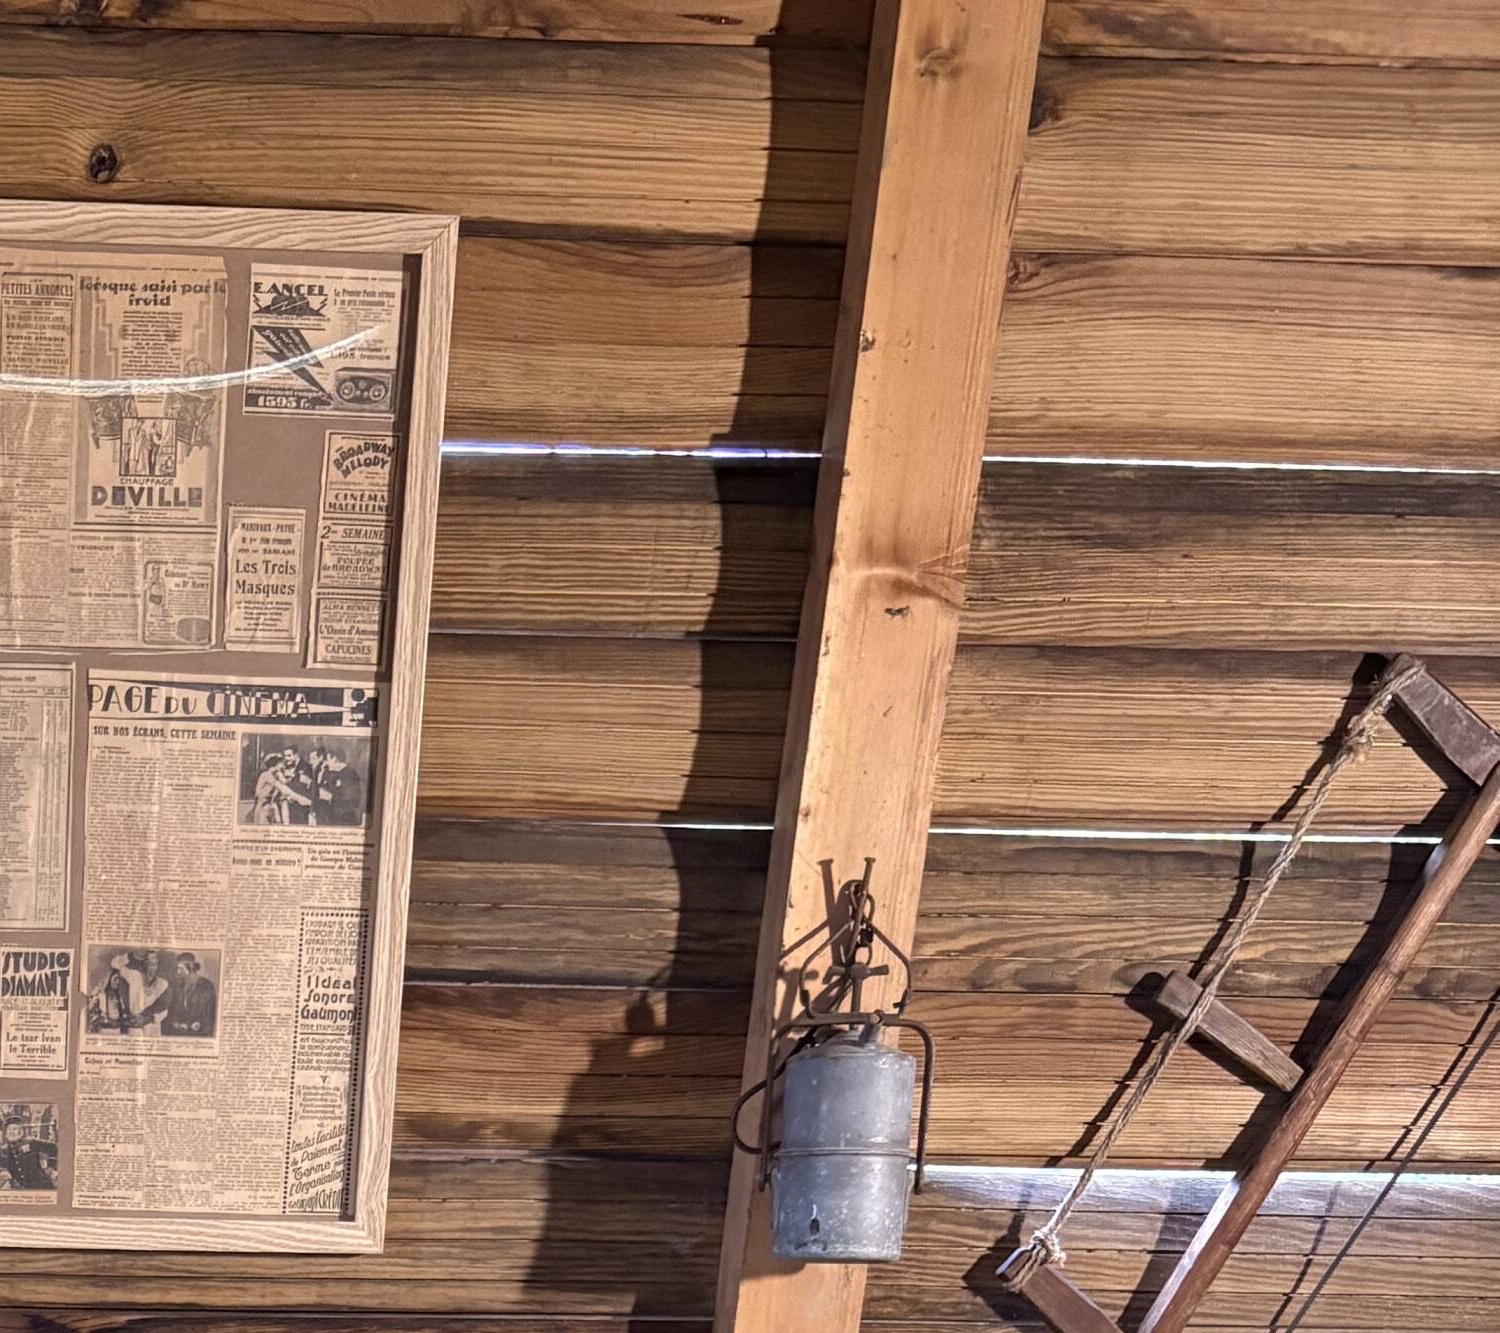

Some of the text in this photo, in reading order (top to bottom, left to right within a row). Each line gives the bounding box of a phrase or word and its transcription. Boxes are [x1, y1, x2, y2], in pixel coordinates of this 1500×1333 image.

[2, 282, 74, 297] PETITES ANNONCES
[142, 280, 177, 292] saisi
[180, 281, 211, 295] par
[128, 295, 171, 307] froid
[258, 395, 297, 408] 1595
[333, 441, 395, 471] BROADWAY
[341, 456, 389, 479] MELODY
[120, 478, 174, 486] CHAUFFAGE
[91, 485, 203, 508] DEVILLE
[334, 490, 387, 504] CINÉMA
[341, 527, 385, 540] SEMAINE
[235, 558, 297, 575] Les Trois
[235, 579, 296, 598] Masques
[325, 643, 371, 656] CAPUCINES
[87, 683, 160, 713] PAGE
[164, 696, 198, 715] DU
[93, 726, 109, 736] SUR
[113, 727, 129, 737] NOS
[170, 728, 197, 739] CETTE
[201, 730, 236, 741] SEMAINE
[2, 951, 70, 975] STUDIO
[1, 970, 70, 998] DIAMANT
[303, 988, 357, 1006] Sonore
[300, 1003, 357, 1024] Gaumont
[6, 1032, 18, 1042] Le
[19, 1044, 57, 1055] Terrible
[301, 1139, 343, 1164] Paiement
[292, 1161, 331, 1181] Terme
